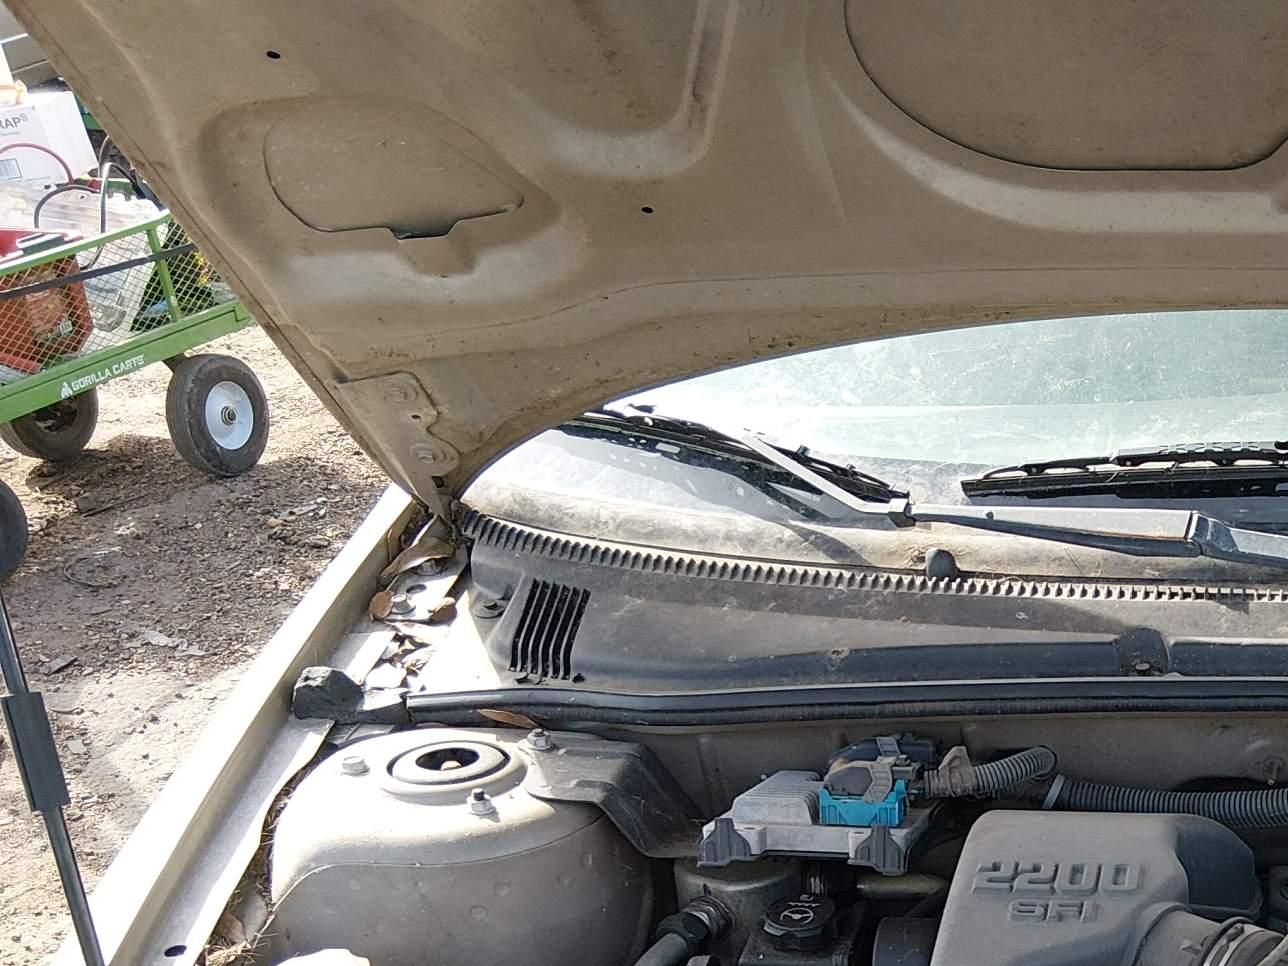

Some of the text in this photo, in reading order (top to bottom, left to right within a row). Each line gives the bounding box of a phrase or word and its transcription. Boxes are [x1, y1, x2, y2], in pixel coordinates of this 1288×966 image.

[71, 356, 145, 391] GORILLA CARTS
[971, 861, 1144, 894] 2200
[1008, 899, 1099, 922] SFI
